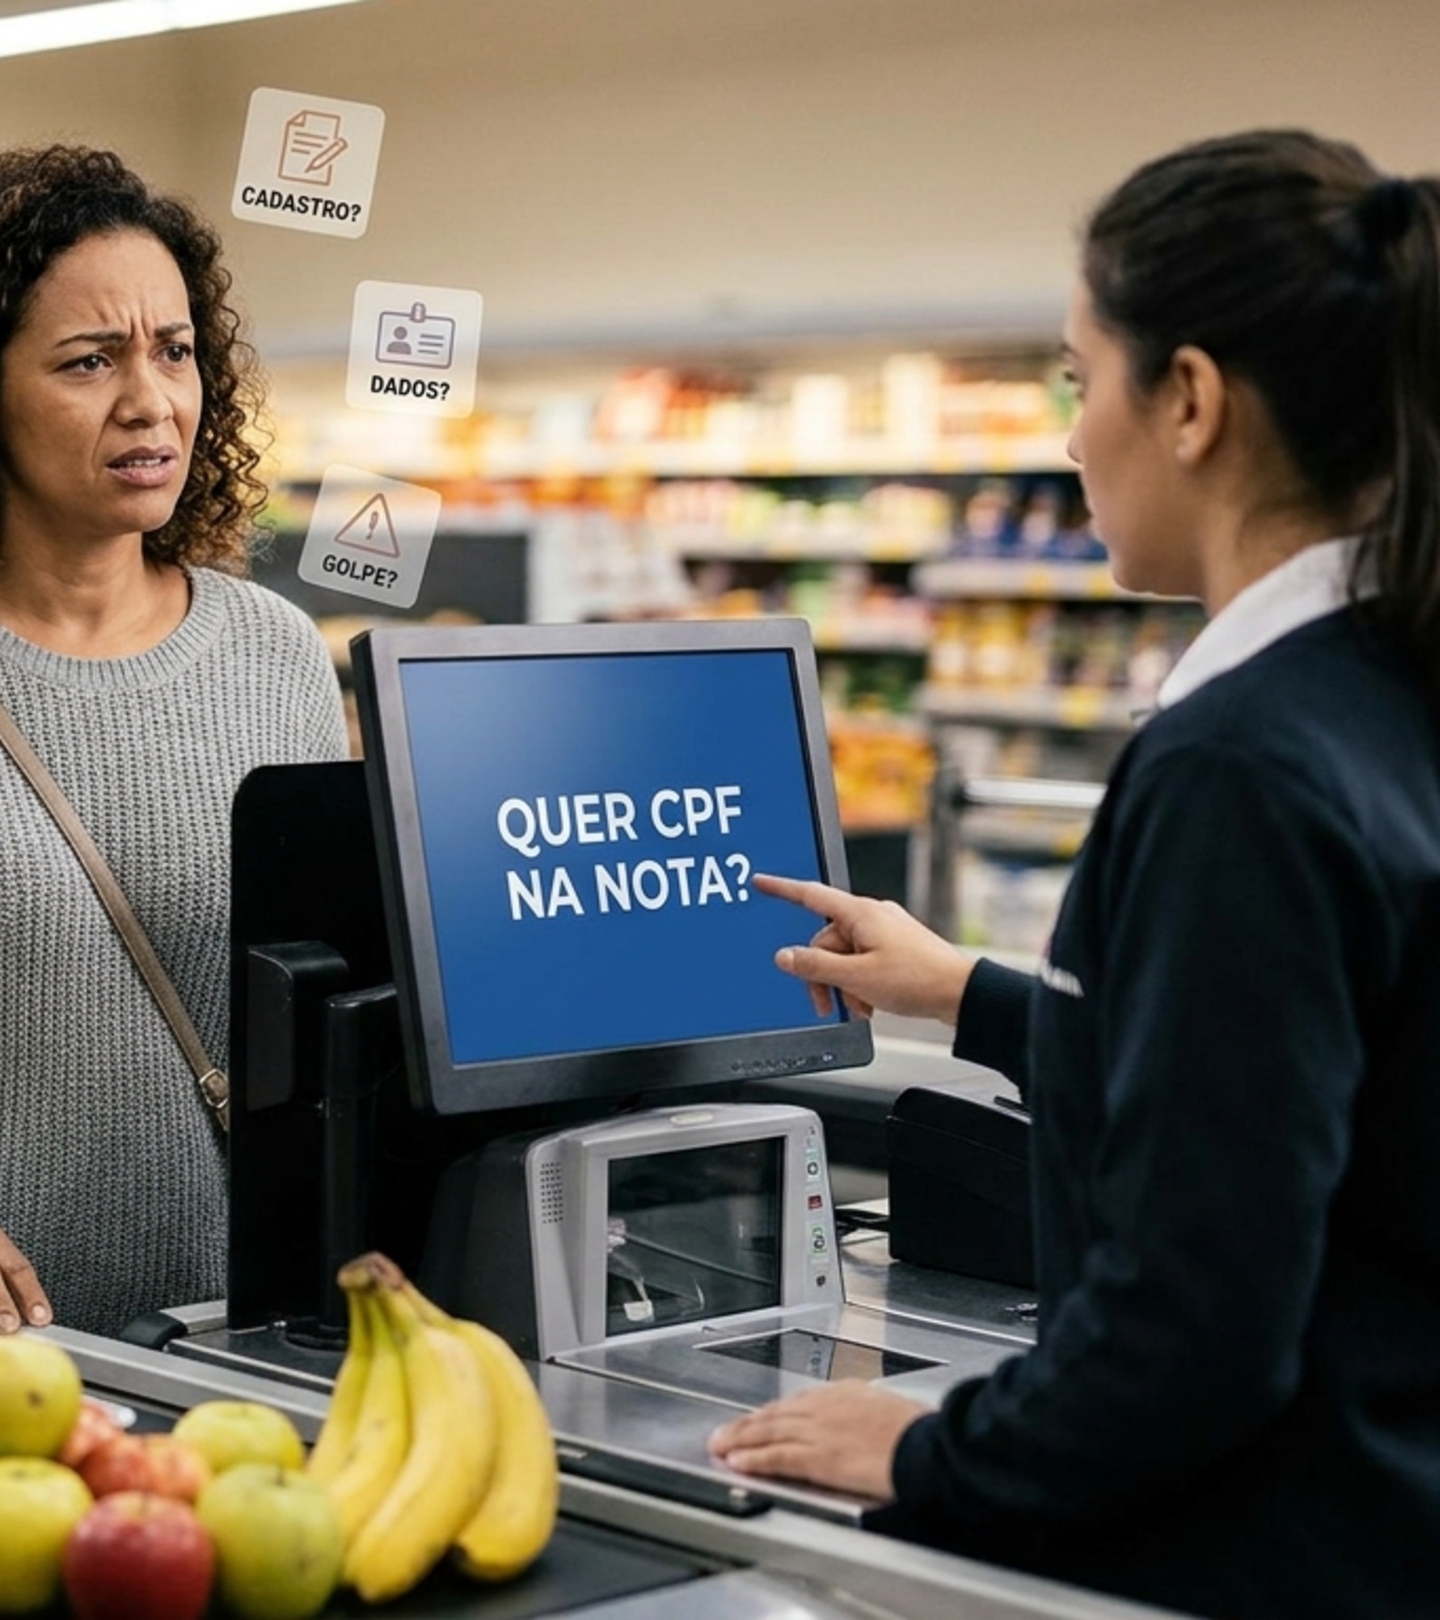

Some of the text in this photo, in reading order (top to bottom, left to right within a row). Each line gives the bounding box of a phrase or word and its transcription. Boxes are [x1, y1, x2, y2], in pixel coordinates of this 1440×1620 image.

[497, 786, 741, 858] QUER CPF
[506, 853, 750, 920] NA NOTA?
